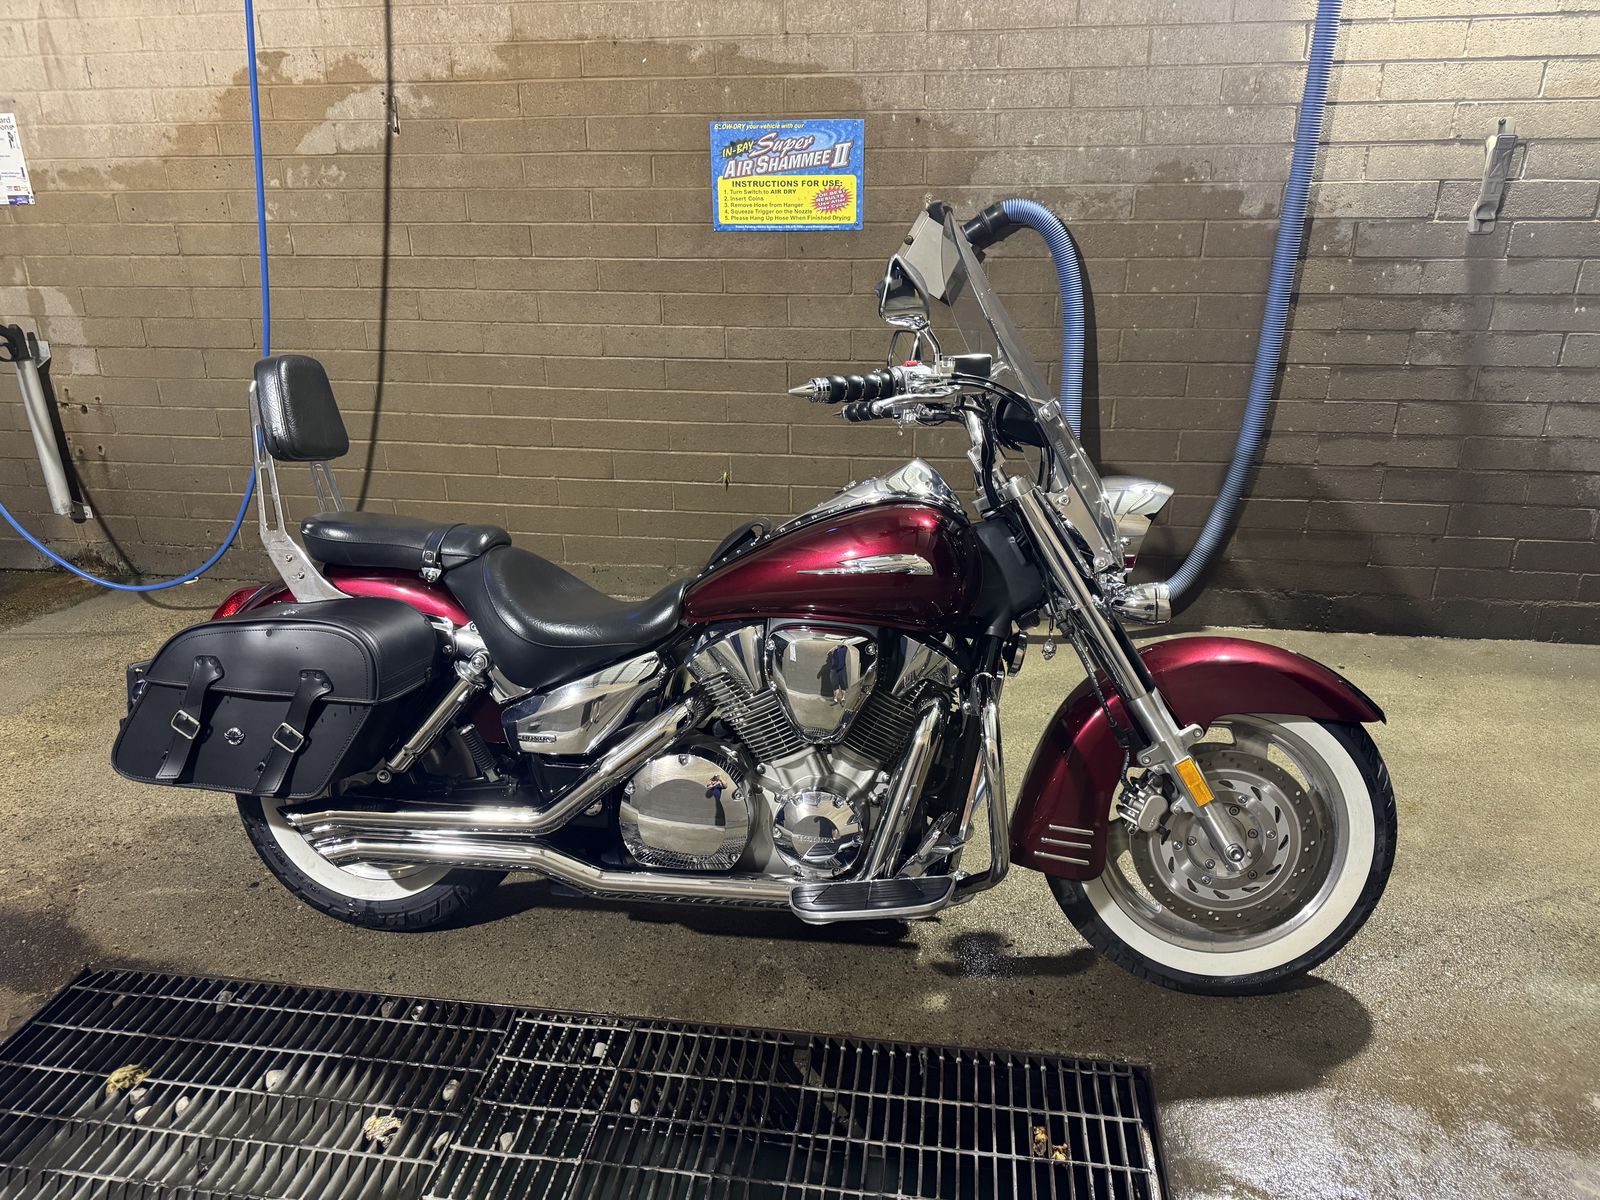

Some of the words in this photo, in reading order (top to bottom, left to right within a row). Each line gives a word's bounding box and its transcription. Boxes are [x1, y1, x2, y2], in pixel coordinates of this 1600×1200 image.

[722, 140, 754, 157] IN-BAY
[748, 132, 814, 157] Super
[724, 159, 753, 178] AIR
[756, 150, 831, 174] SHAMMEE
[832, 142, 852, 167] II
